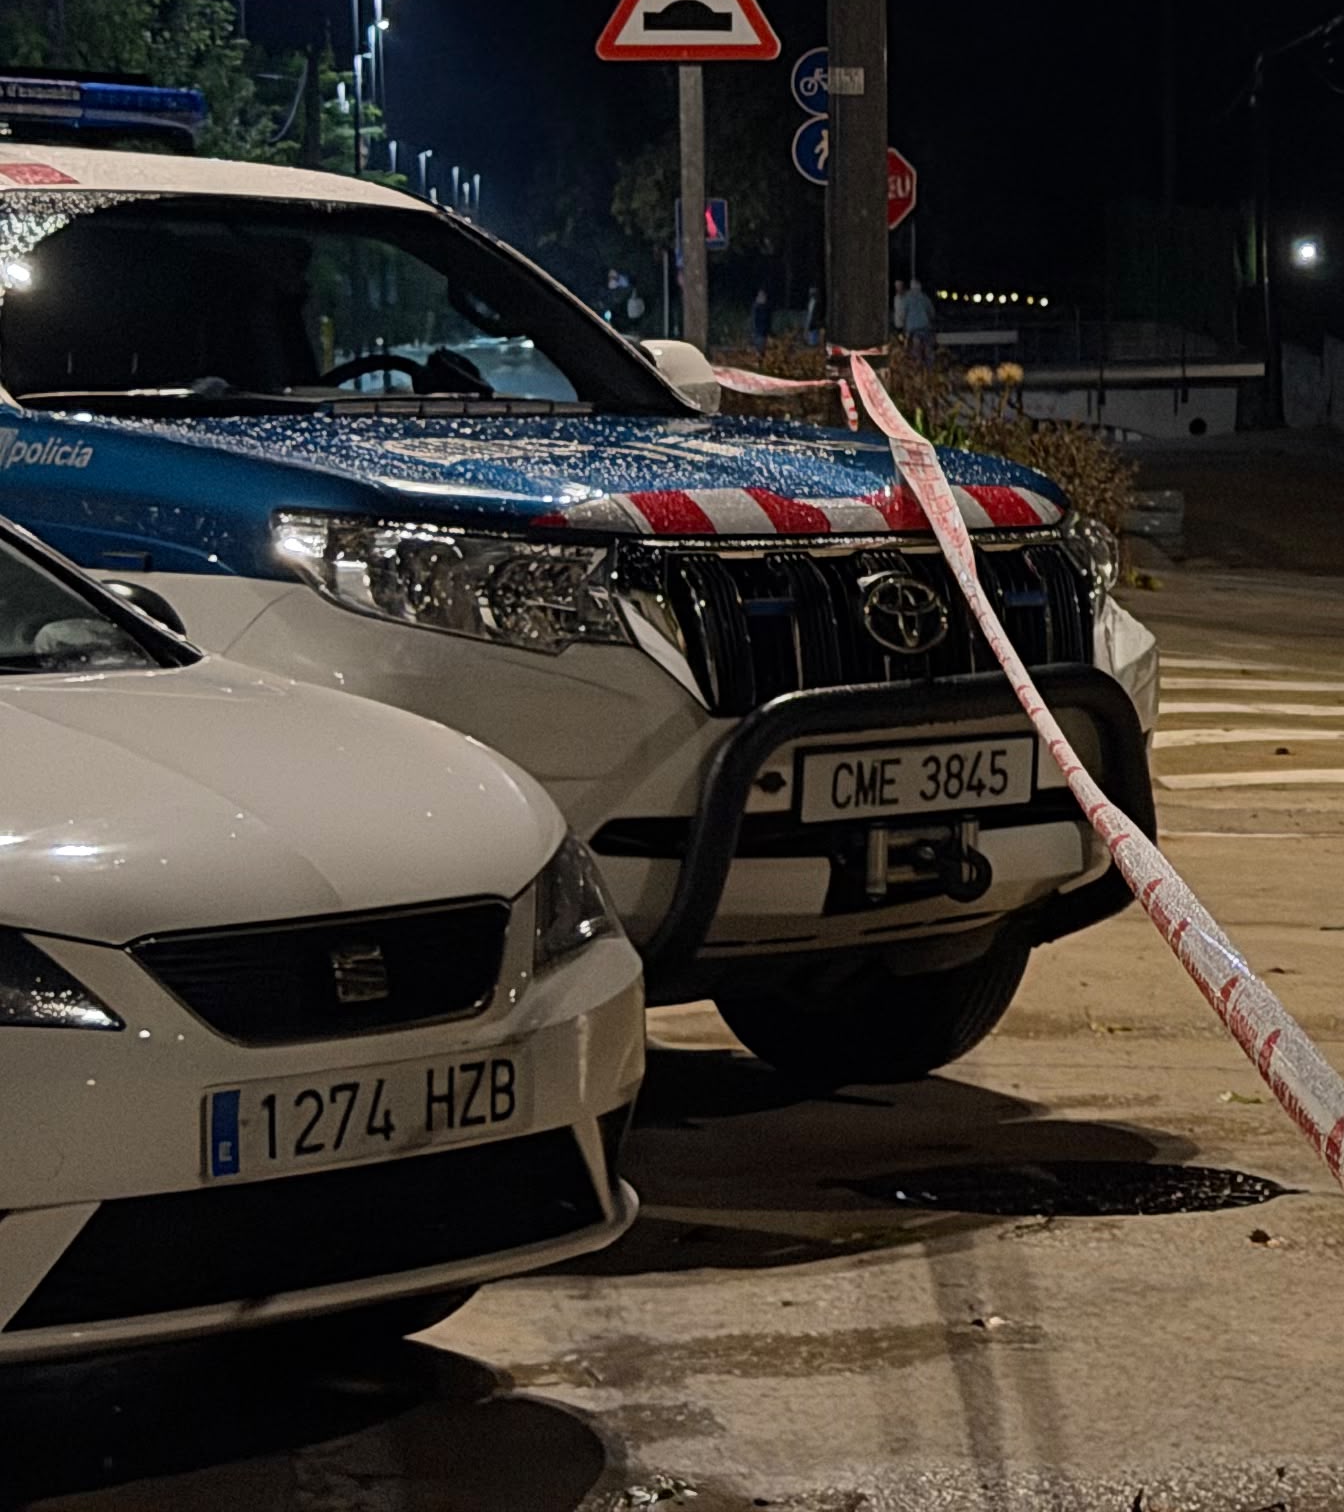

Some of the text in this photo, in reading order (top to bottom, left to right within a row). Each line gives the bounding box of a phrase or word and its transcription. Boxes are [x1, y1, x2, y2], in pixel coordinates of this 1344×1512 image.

[832, 749, 1008, 809] CME 3845
[218, 1058, 516, 1162] E 1274 HZB
